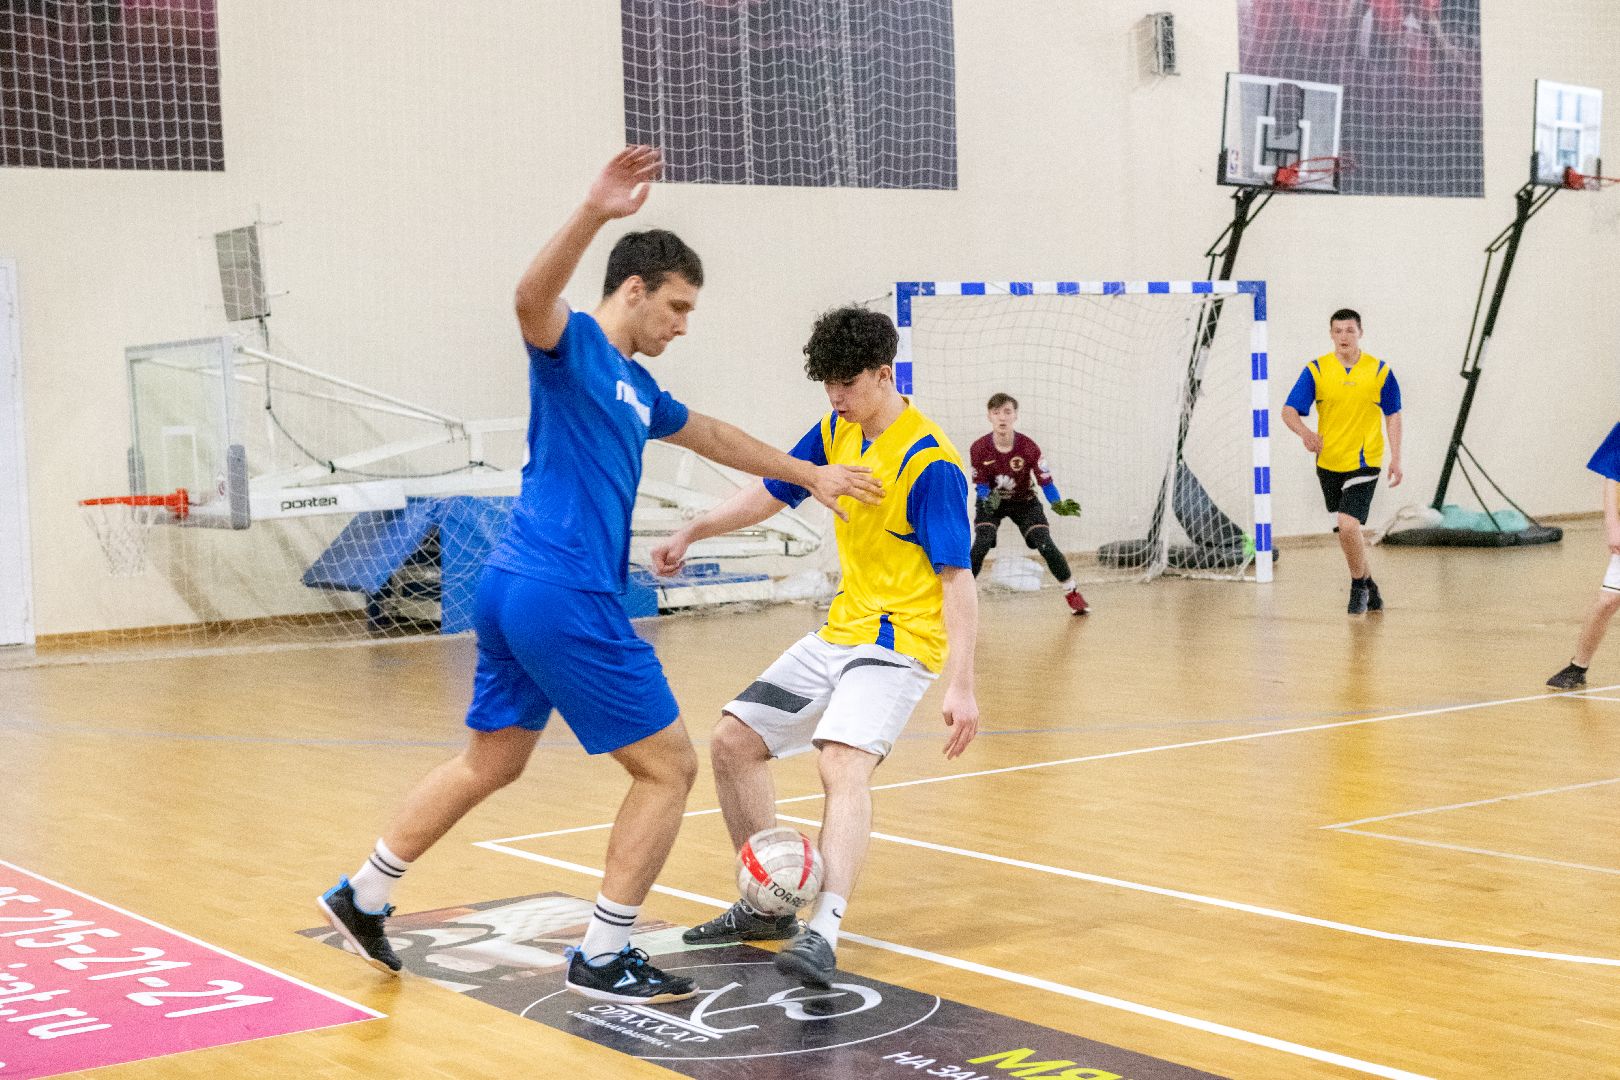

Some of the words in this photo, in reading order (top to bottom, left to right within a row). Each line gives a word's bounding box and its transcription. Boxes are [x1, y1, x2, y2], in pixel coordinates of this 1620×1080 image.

[769, 881, 808, 908] TORRE
[882, 1051, 937, 1069] НА
[926, 1065, 990, 1080] ЗА
